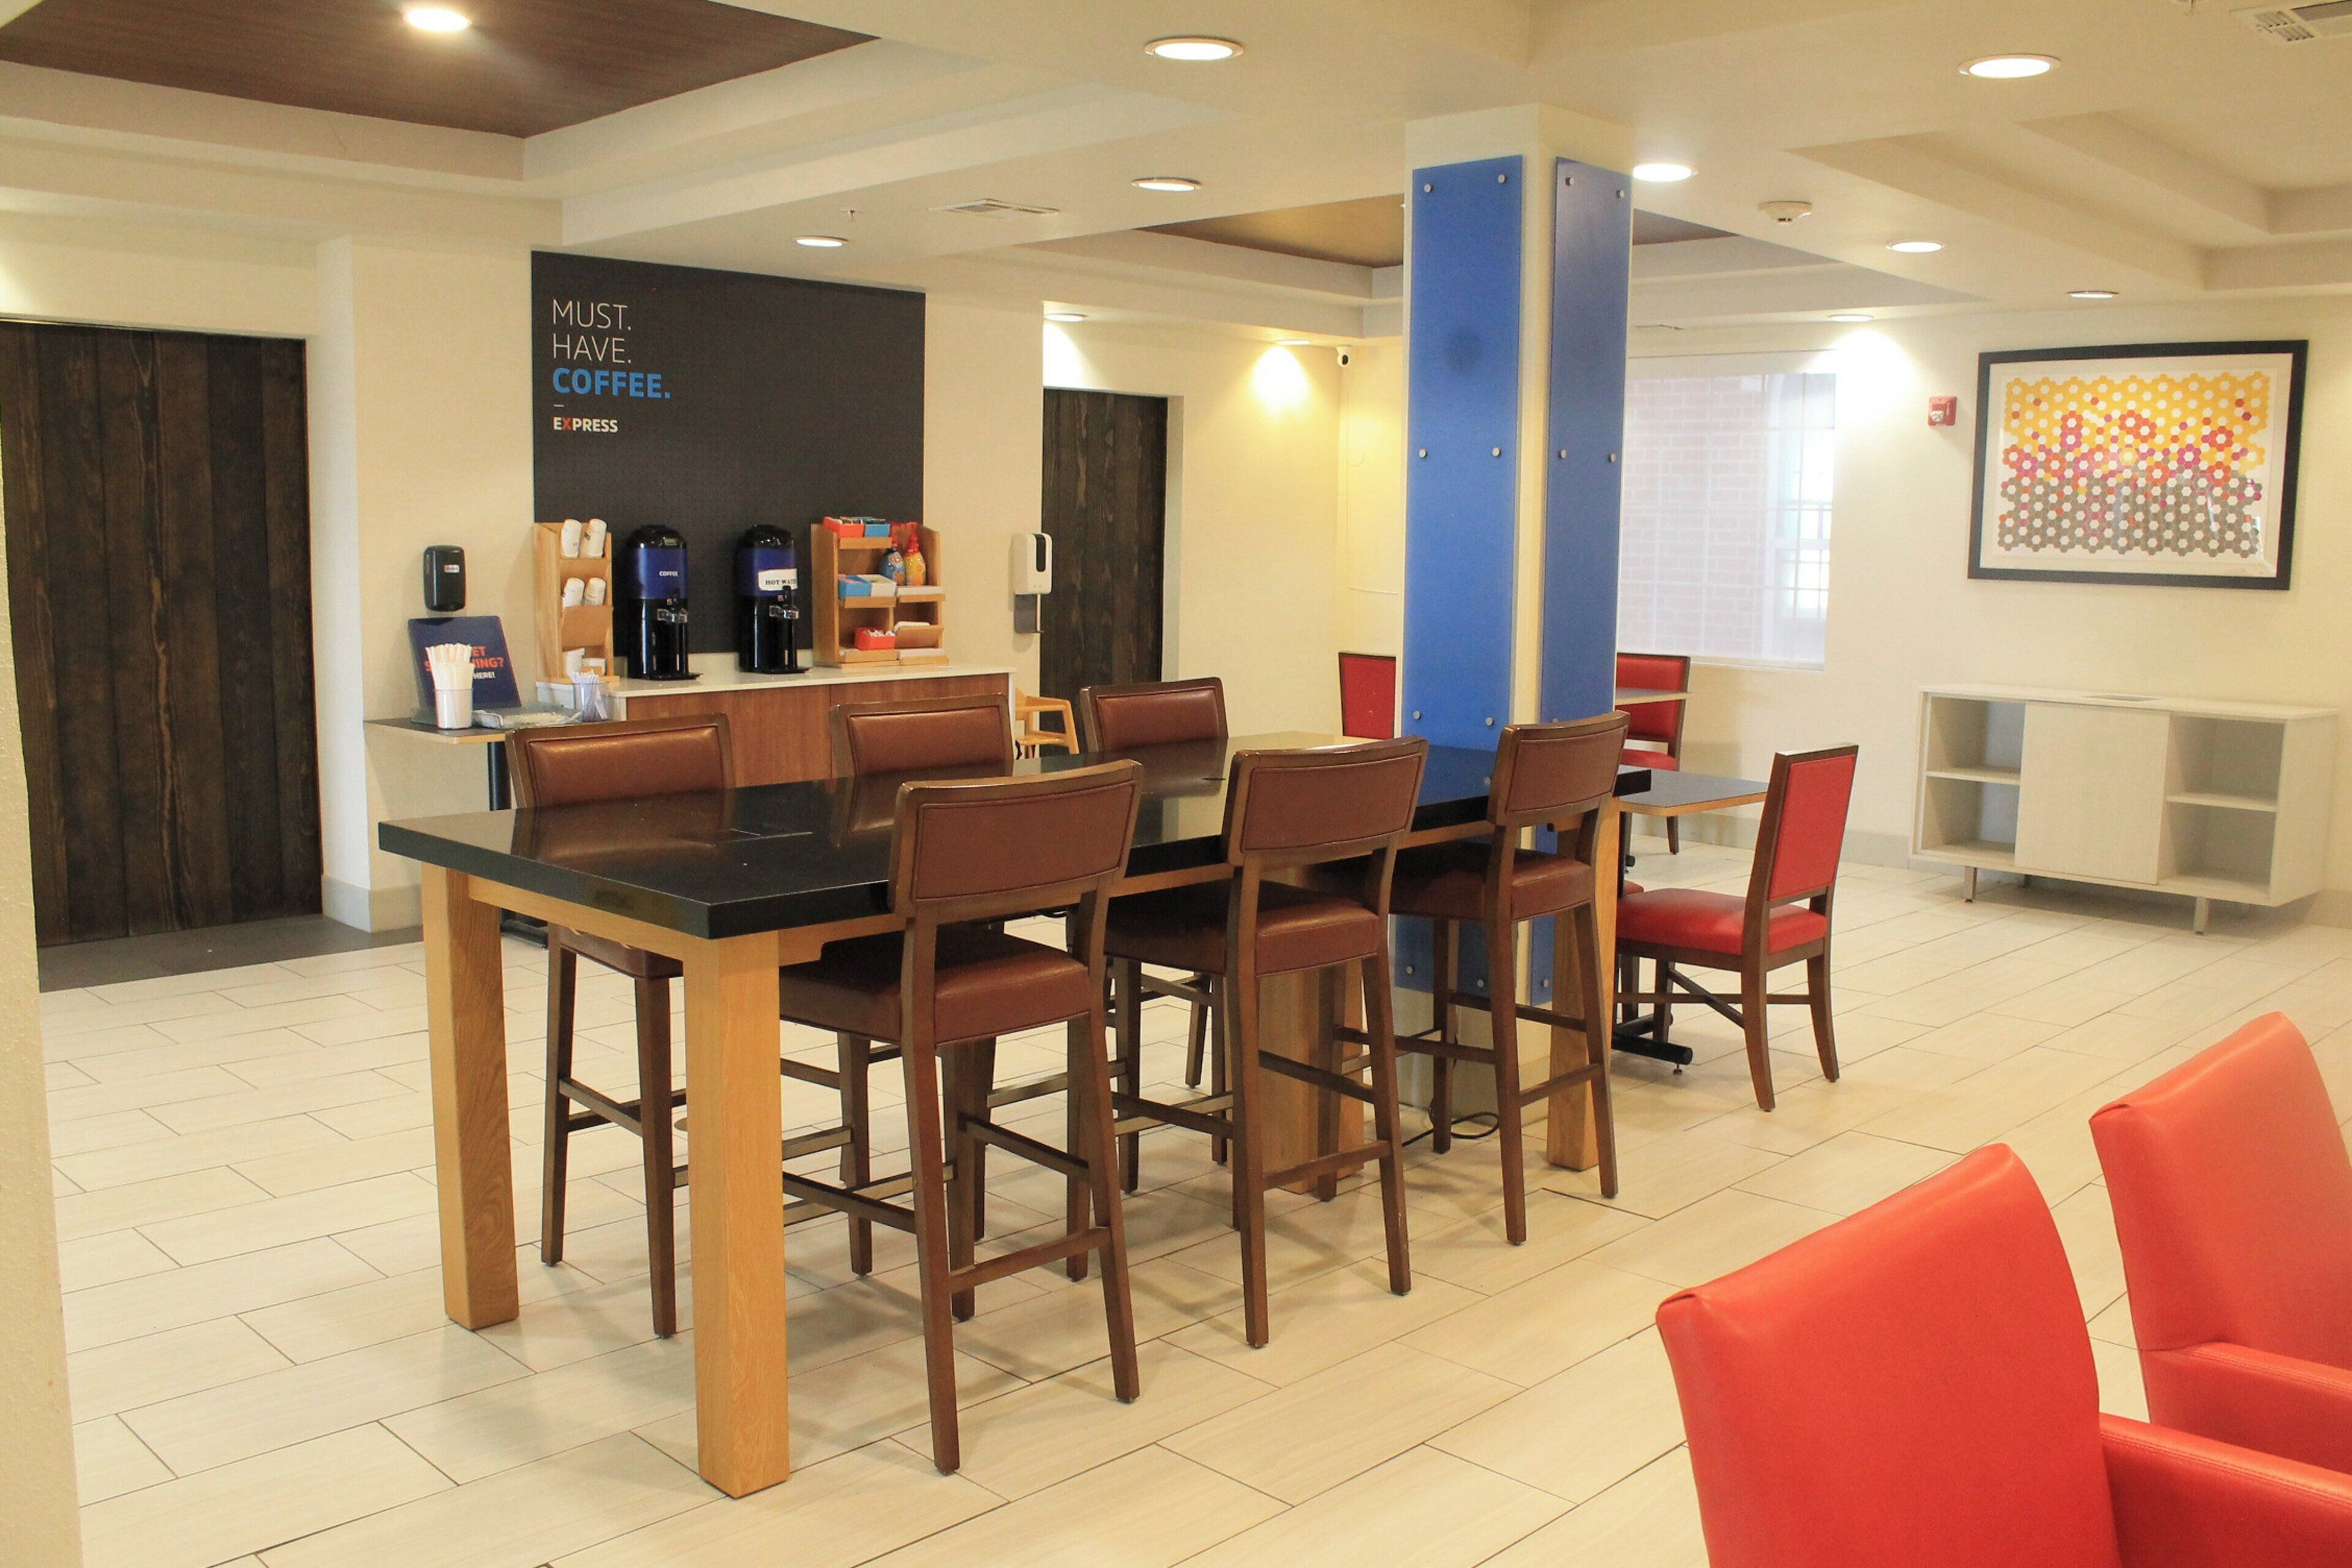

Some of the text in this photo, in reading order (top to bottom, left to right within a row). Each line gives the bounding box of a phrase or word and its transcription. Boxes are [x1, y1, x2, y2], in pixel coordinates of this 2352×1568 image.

[552, 298, 631, 330] MUST.
[553, 333, 631, 364] HAVE.
[553, 368, 671, 398] COFFEE.
[553, 417, 619, 433] EXPRESS
